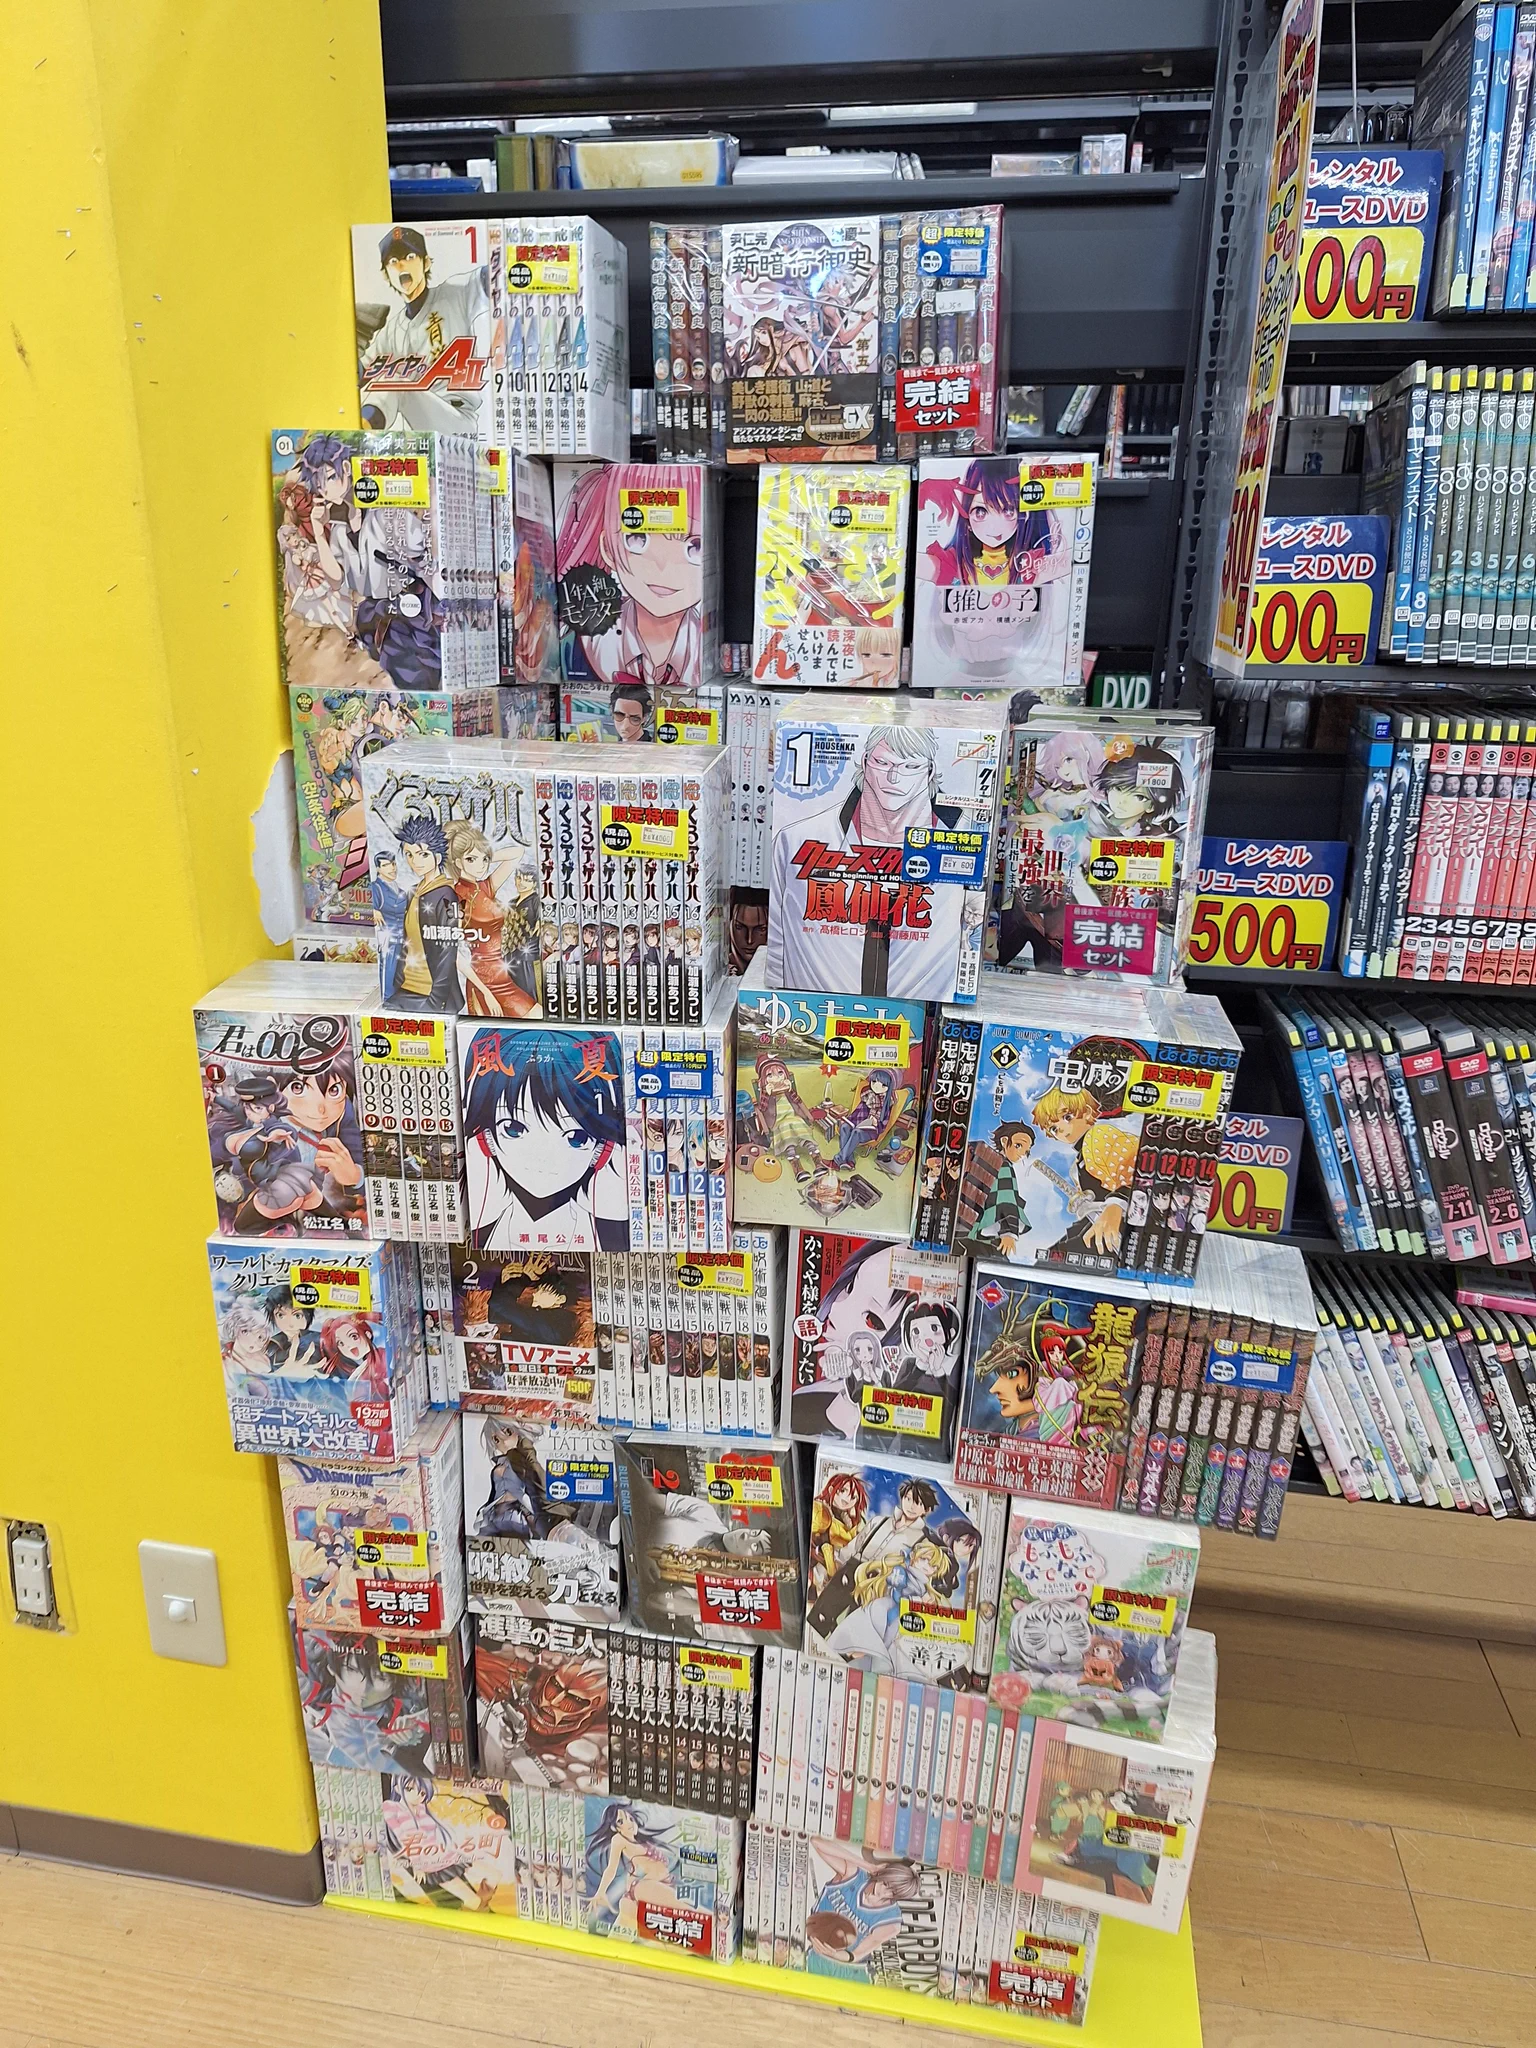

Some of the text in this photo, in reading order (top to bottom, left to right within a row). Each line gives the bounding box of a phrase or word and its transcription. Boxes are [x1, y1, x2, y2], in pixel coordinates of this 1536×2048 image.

[464, 226, 477, 264] 1
[731, 246, 874, 278] 新暗行御史
[495, 372, 504, 393] 9
[509, 372, 524, 393] 10
[526, 372, 538, 393] 11
[542, 372, 557, 393] 12
[558, 372, 572, 393] 13
[574, 372, 588, 393] 14
[904, 377, 971, 409] 完結
[914, 407, 961, 426] セット
[1261, 521, 1352, 549] レンタル
[1486, 553, 1498, 569] 5
[1522, 553, 1534, 569] 6
[943, 586, 1042, 615] 【推しの子】
[1399, 583, 1411, 601] 7
[1414, 591, 1427, 609] 8
[562, 601, 624, 628] モンスター
[796, 628, 810, 662] せん。
[812, 630, 825, 670] いけま
[842, 629, 856, 670] 深夜に
[826, 629, 840, 683] 読んでは
[562, 682, 610, 692] おおのこうすけ
[1102, 676, 1150, 709] DVD
[562, 695, 572, 724] 1
[814, 741, 855, 752] HOUSENKA
[786, 731, 814, 786] 1
[611, 805, 679, 826] 限定特価
[604, 827, 628, 837] 現品
[911, 829, 927, 844] 超
[933, 831, 983, 846] 限定特価
[538, 801, 555, 901] くろアゲハ
[558, 801, 575, 901] くろアゲハ
[579, 801, 597, 901] くろアゲハ
[1100, 840, 1165, 859] 限定特価
[1225, 843, 1313, 869] レンタル
[1006, 838, 1021, 897] 目指します
[1018, 828, 1044, 904] 最強を
[1093, 861, 1116, 869] 現品
[1042, 850, 1065, 906] 世界
[1199, 871, 1335, 898] リユースDVD
[803, 878, 934, 929] 鳳仙花
[422, 925, 491, 942] 加瀬あつし
[1072, 919, 1146, 950] 完結
[1190, 899, 1323, 970] 500円
[1421, 919, 1438, 935] 3
[1437, 919, 1454, 935] 4
[1453, 919, 1471, 935] 5
[1471, 918, 1488, 934] 6
[1488, 921, 1506, 937] 7
[1505, 922, 1522, 938] 8
[1082, 949, 1132, 966] セット
[546, 964, 558, 1014] 加瀬あつし
[585, 964, 598, 1014] 加瀬あつし
[626, 964, 638, 1014] 加瀬あつし
[646, 964, 657, 1014] 加瀬あつし
[370, 1017, 435, 1036] 限定特価
[835, 1020, 902, 1040] 限定特価
[991, 1029, 1041, 1041] JUMP COMICS
[467, 1032, 620, 1084] 風 夏
[639, 1051, 655, 1064] 超
[660, 1051, 707, 1063] 限定特価
[1000, 1050, 1010, 1065] 3
[1414, 1056, 1434, 1070] DVD
[1460, 1058, 1480, 1070] DVD
[934, 1039, 959, 1097] 鬼滅の刃
[953, 1040, 978, 1098] 鬼滅の刃
[1141, 1063, 1214, 1090] 限定特価
[1228, 1117, 1270, 1139] タル
[950, 1129, 961, 1149] 2
[647, 1154, 664, 1172] 10
[1141, 1154, 1155, 1171] 11
[1161, 1155, 1177, 1174] 12
[1180, 1158, 1195, 1177] 13
[1199, 1159, 1215, 1178] 14
[628, 1154, 642, 1197] 瀬尾公治
[669, 1174, 685, 1192] 11
[689, 1174, 705, 1193] 12
[444, 1183, 456, 1211] 松江名
[709, 1177, 725, 1196] 13
[677, 1199, 686, 1240] アホガール
[1443, 1199, 1475, 1221] 7-11
[1489, 1202, 1519, 1224] 2-6
[303, 1215, 363, 1231] 松江名 俊
[711, 1200, 724, 1242] 瀬尾公治
[519, 1233, 585, 1244] 瀬尾公治
[685, 1253, 743, 1267] 限定特価
[299, 1267, 360, 1286] 限定特価
[461, 1260, 480, 1286] 2
[796, 1235, 824, 1386] かぐや様を語りたい
[702, 1319, 715, 1332] 16
[737, 1320, 749, 1333] 18
[755, 1321, 768, 1334] 19
[502, 1343, 591, 1367] TVアニメ
[1078, 1302, 1139, 1427] 龍狼伝
[232, 1405, 357, 1431] 超チートスキルで
[355, 1407, 389, 1419] 19万部
[235, 1423, 378, 1455] 異世界大改革!
[550, 1436, 615, 1452] TATTOO
[320, 1462, 374, 1473] ドラゴンクエスト
[960, 1444, 1025, 1473] 中原に集いし
[618, 1465, 629, 1488] BLUE
[714, 1466, 772, 1482] 限定特価
[330, 1487, 370, 1500] 幻の大地
[467, 1539, 496, 1552] この
[366, 1588, 430, 1613] 完結
[705, 1586, 772, 1611] 完結
[379, 1612, 421, 1627] セット
[718, 1610, 762, 1624] セット
[478, 1618, 604, 1658] 進撃の巨人
[908, 1646, 958, 1671] 善行
[398, 1832, 505, 1862] 君のいる町
[645, 1911, 705, 1938] 完結
[654, 1932, 694, 1949] セット
[999, 1971, 1065, 2000] 完結
[1008, 1991, 1054, 2009] セット
